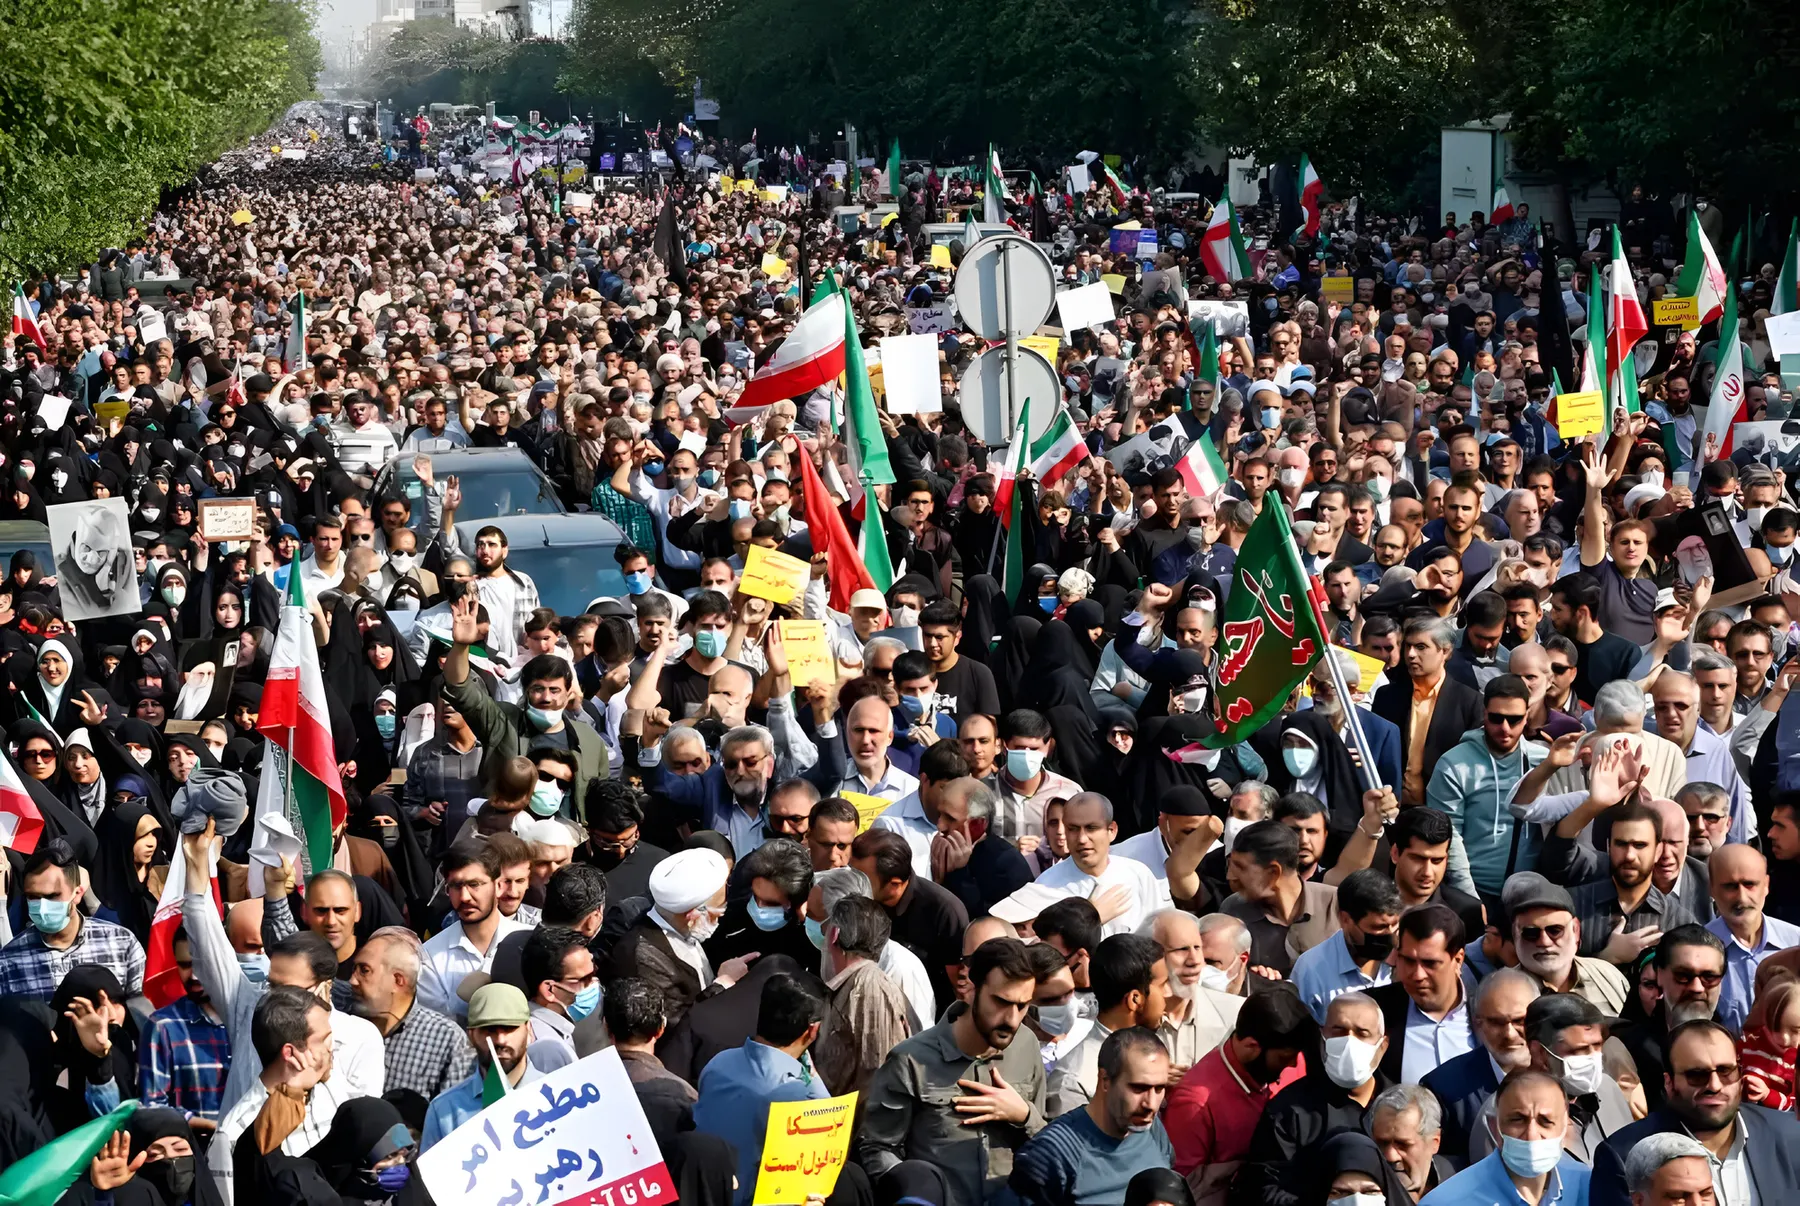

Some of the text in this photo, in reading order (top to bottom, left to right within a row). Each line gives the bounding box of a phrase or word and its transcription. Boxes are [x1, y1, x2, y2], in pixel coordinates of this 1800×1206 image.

[461, 1082, 601, 1194] مطیع امر
[619, 1182, 639, 1206] تا
[639, 1177, 662, 1198] ما
